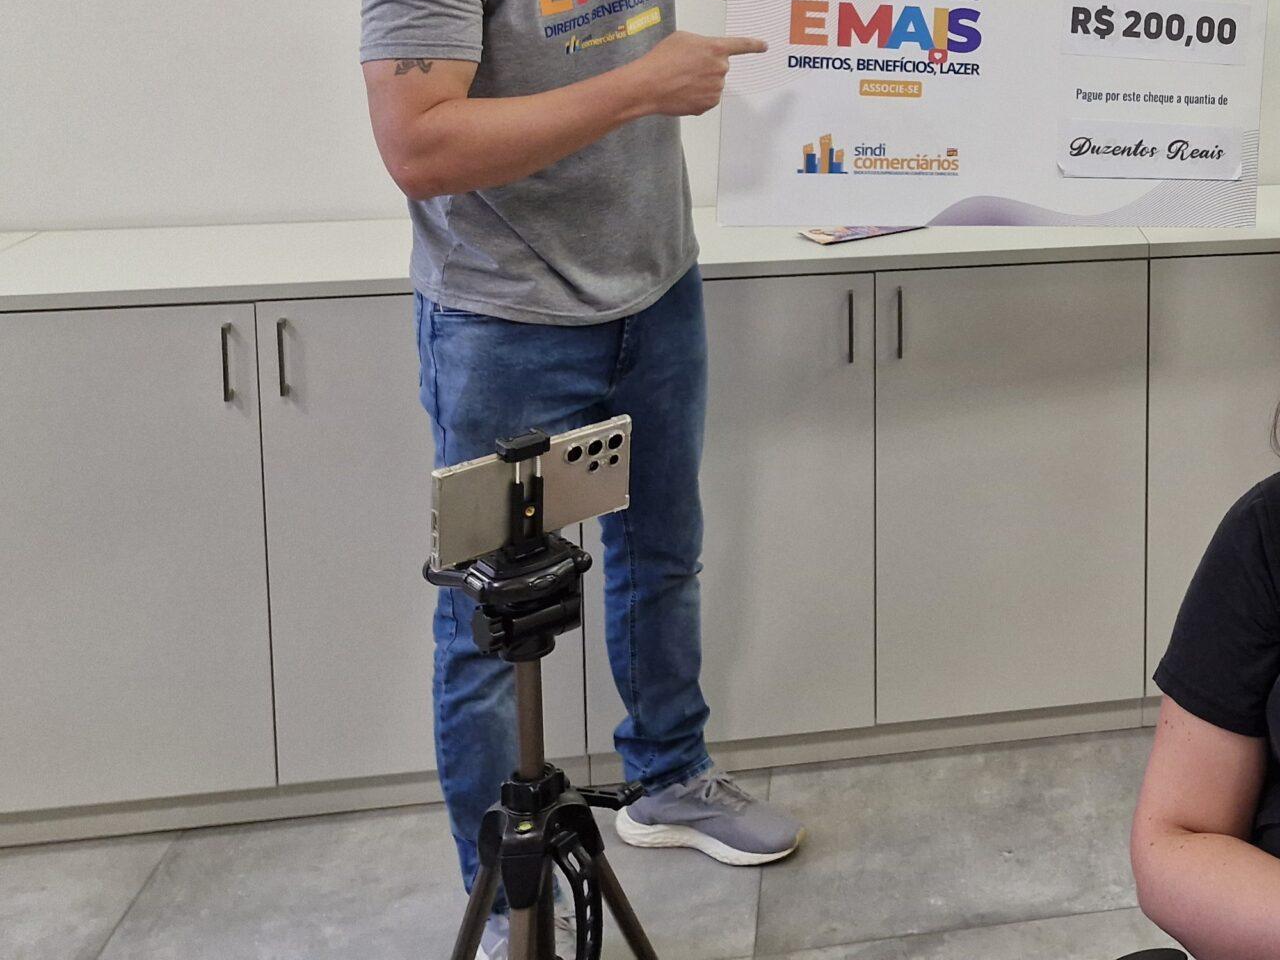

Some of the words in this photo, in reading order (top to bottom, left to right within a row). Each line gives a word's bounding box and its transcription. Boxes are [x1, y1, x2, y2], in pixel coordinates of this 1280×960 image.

[837, 1, 982, 54] MAIS
[1070, 5, 1115, 39] R$
[1122, 10, 1237, 47] 200,00
[788, 55, 853, 72] DIREITOS,
[856, 57, 937, 75] BENEFÍCIOS,
[939, 62, 980, 76] LAZER
[862, 84, 920, 94] ASSOCIE-SE
[1076, 88, 1103, 102] Pague
[1105, 91, 1120, 103] por
[1122, 91, 1141, 102] este
[1143, 92, 1174, 105] cheque
[1184, 93, 1216, 106] quantia
[1217, 94, 1228, 105] de
[854, 143, 886, 156] sindi
[1069, 136, 1158, 159] Duzentos
[1166, 139, 1225, 161] Reais
[853, 154, 959, 171] comerciários
